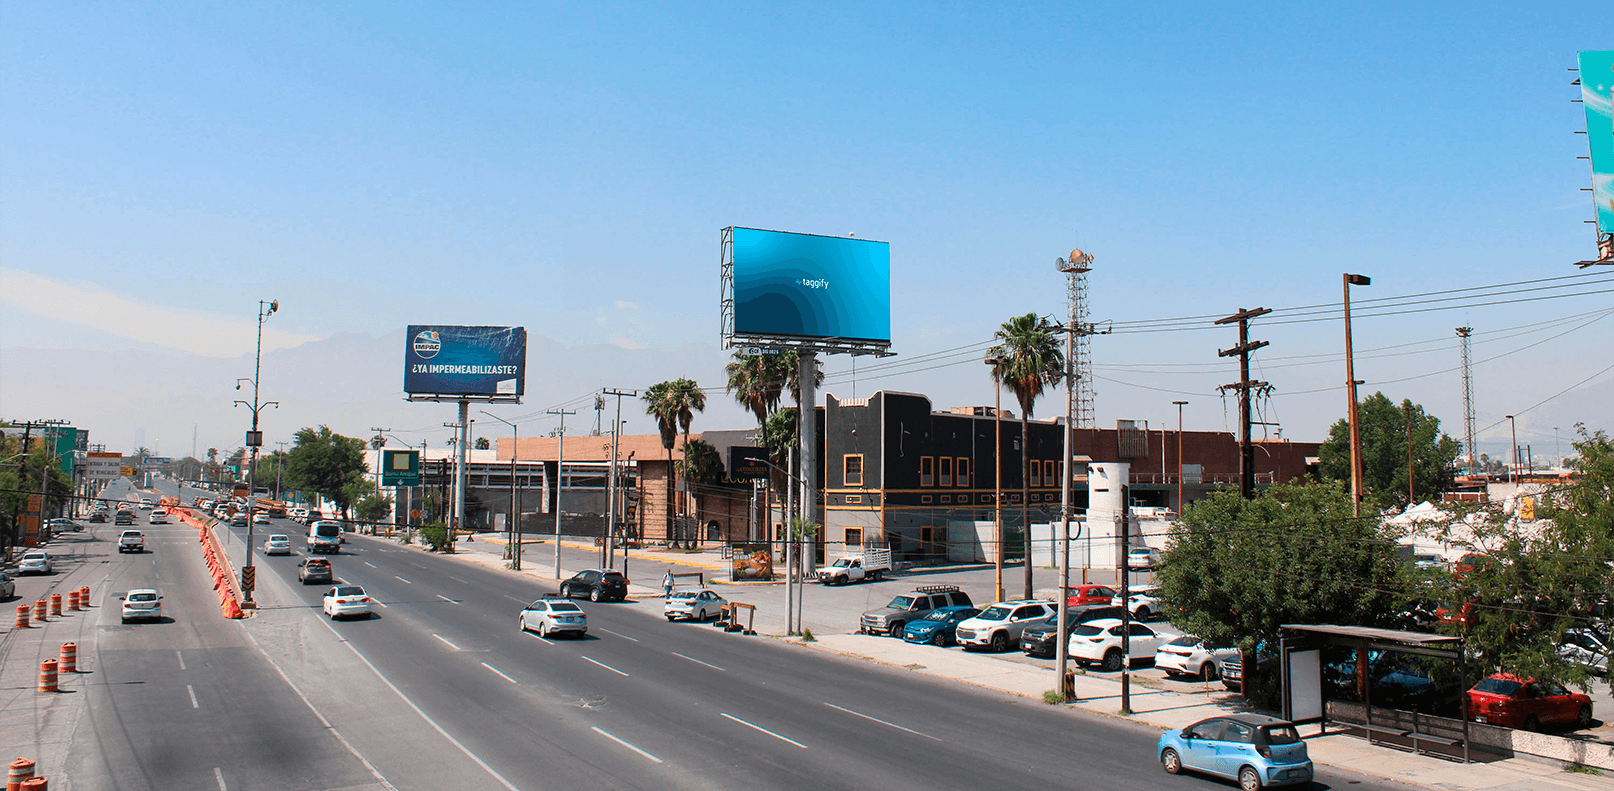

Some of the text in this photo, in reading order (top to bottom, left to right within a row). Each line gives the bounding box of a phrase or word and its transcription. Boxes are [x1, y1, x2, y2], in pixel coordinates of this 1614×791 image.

[802, 278, 829, 289] taggify
[412, 364, 518, 374] ¿YA IMPERMEABILIZASTE?
